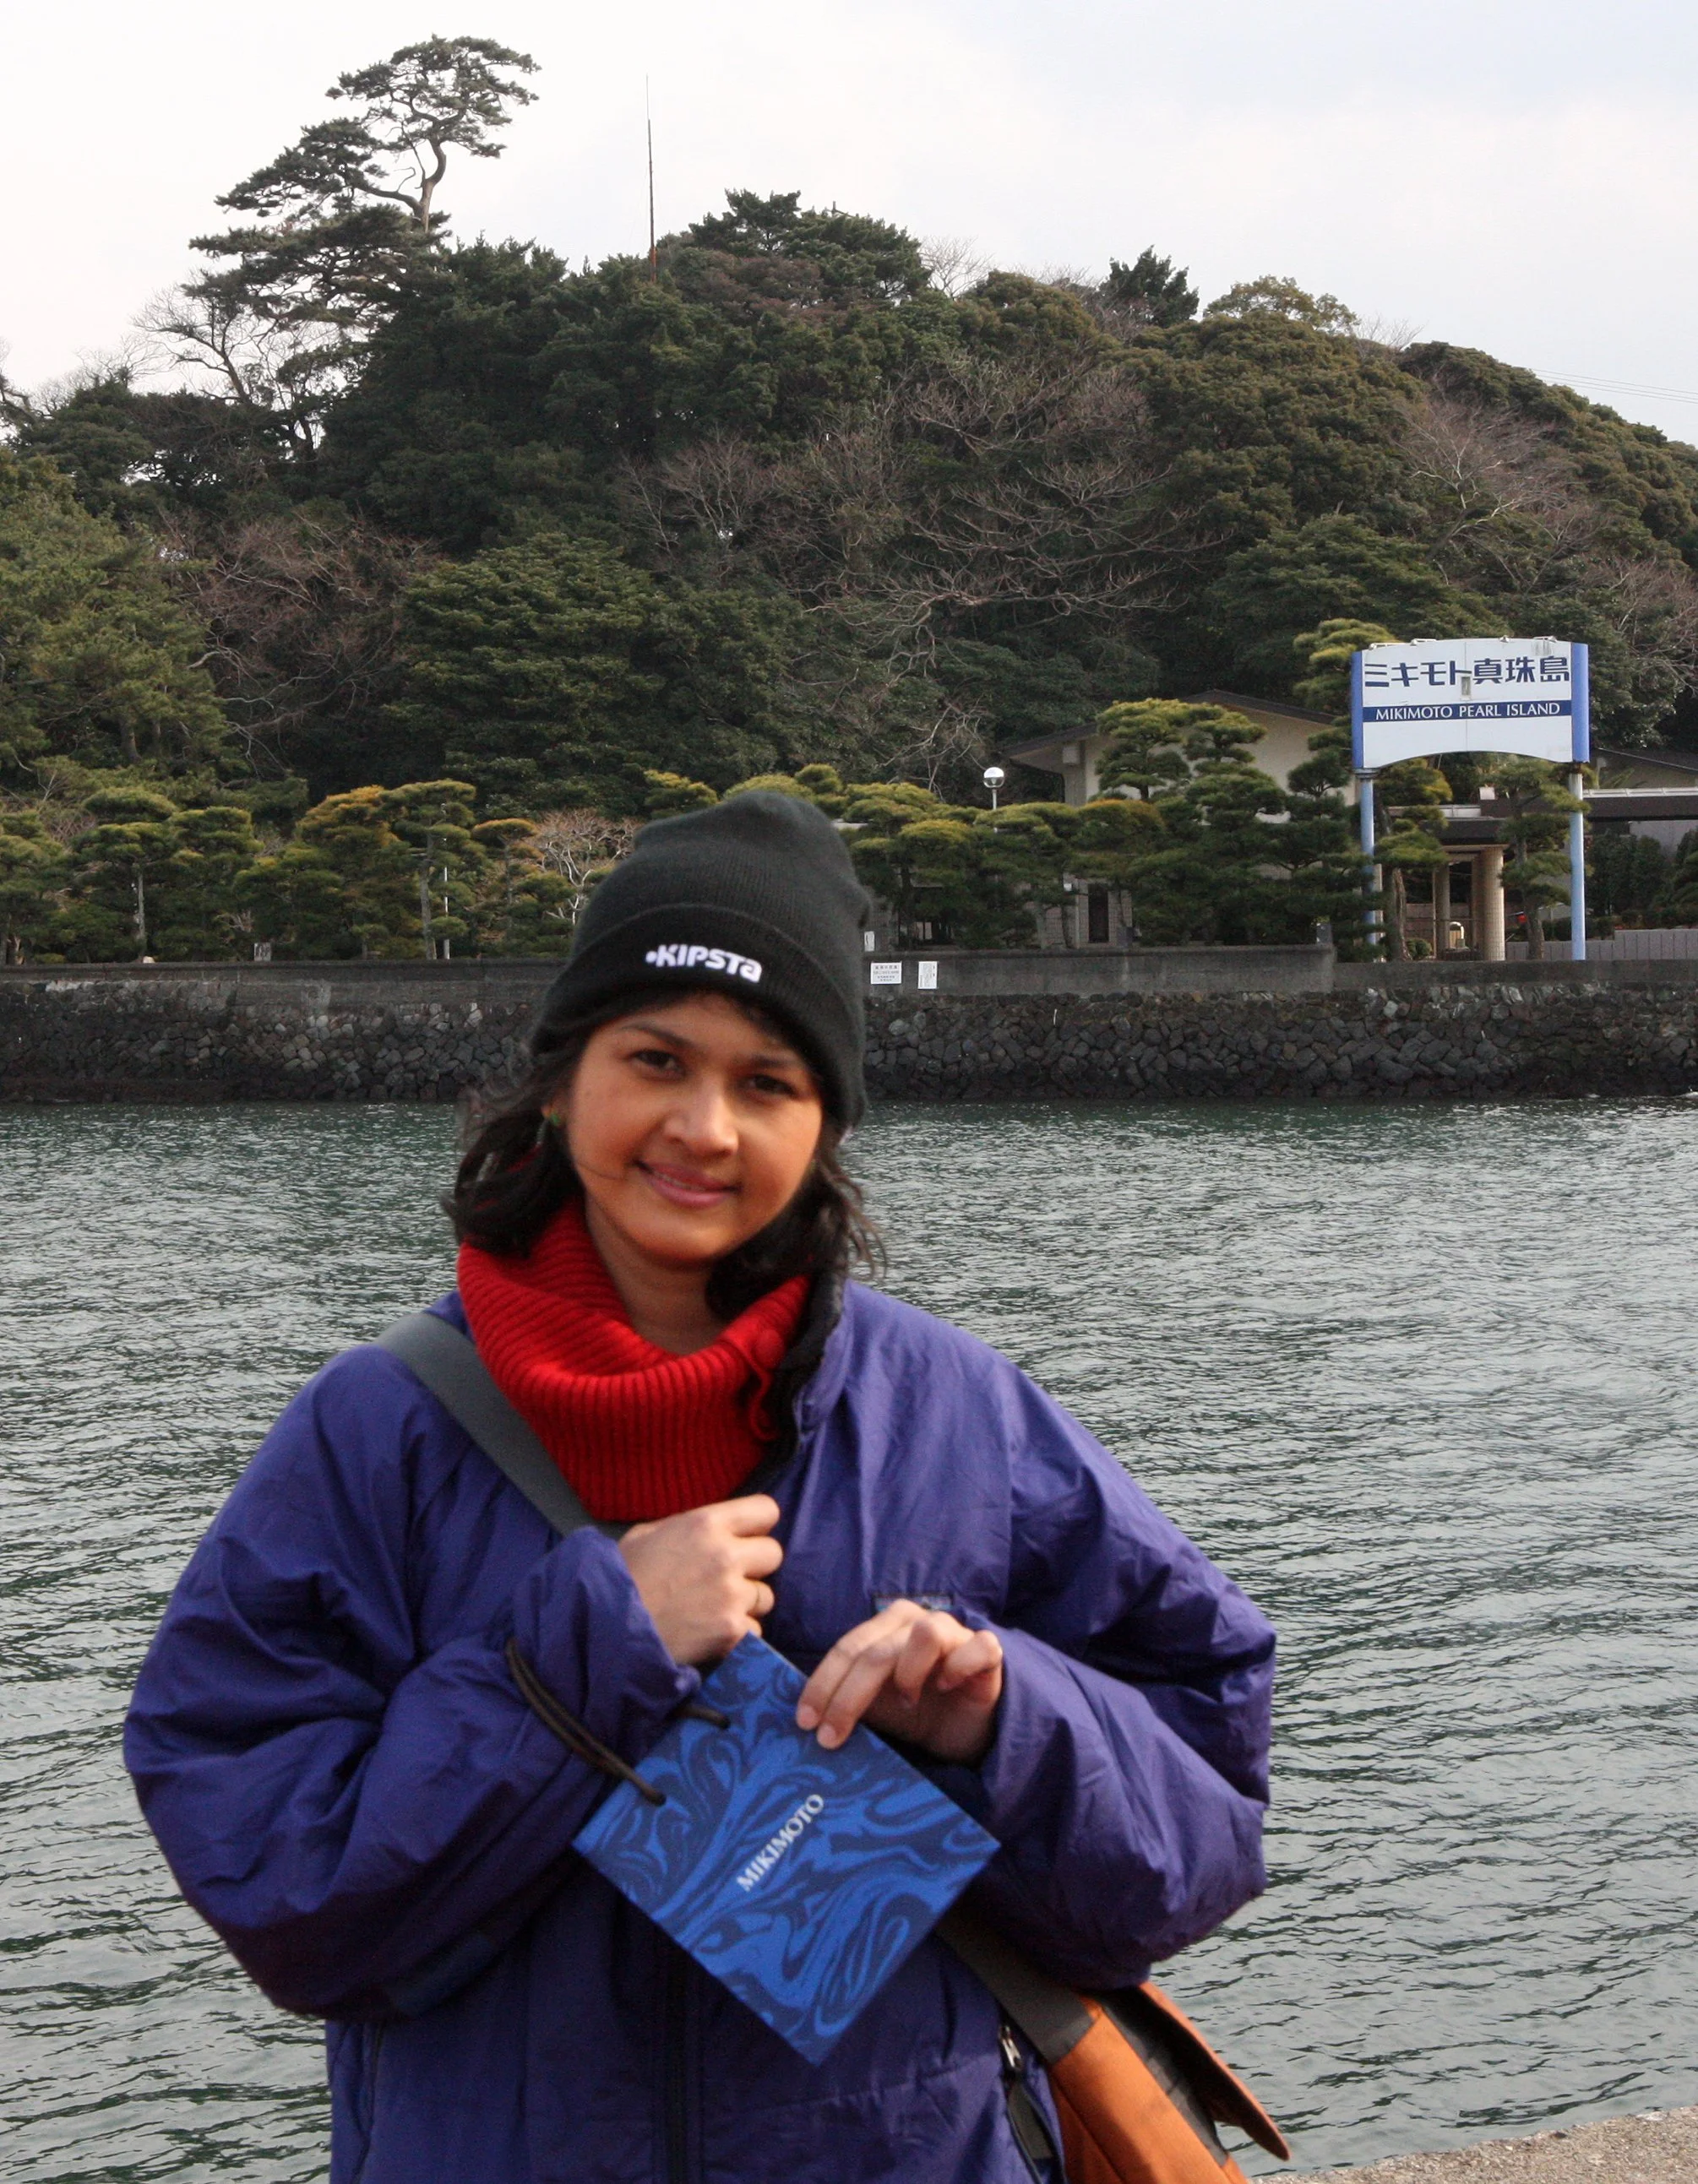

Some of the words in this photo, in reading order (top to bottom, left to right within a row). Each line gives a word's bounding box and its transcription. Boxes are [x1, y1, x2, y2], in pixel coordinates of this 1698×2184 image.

[1364, 655, 1570, 687] ミキモト真珠島
[1375, 706, 1453, 720] MIKIMOTO
[1459, 704, 1501, 717] PEARL
[1506, 702, 1560, 716] ISLAND
[736, 1794, 825, 1893] MIKIMOTO
